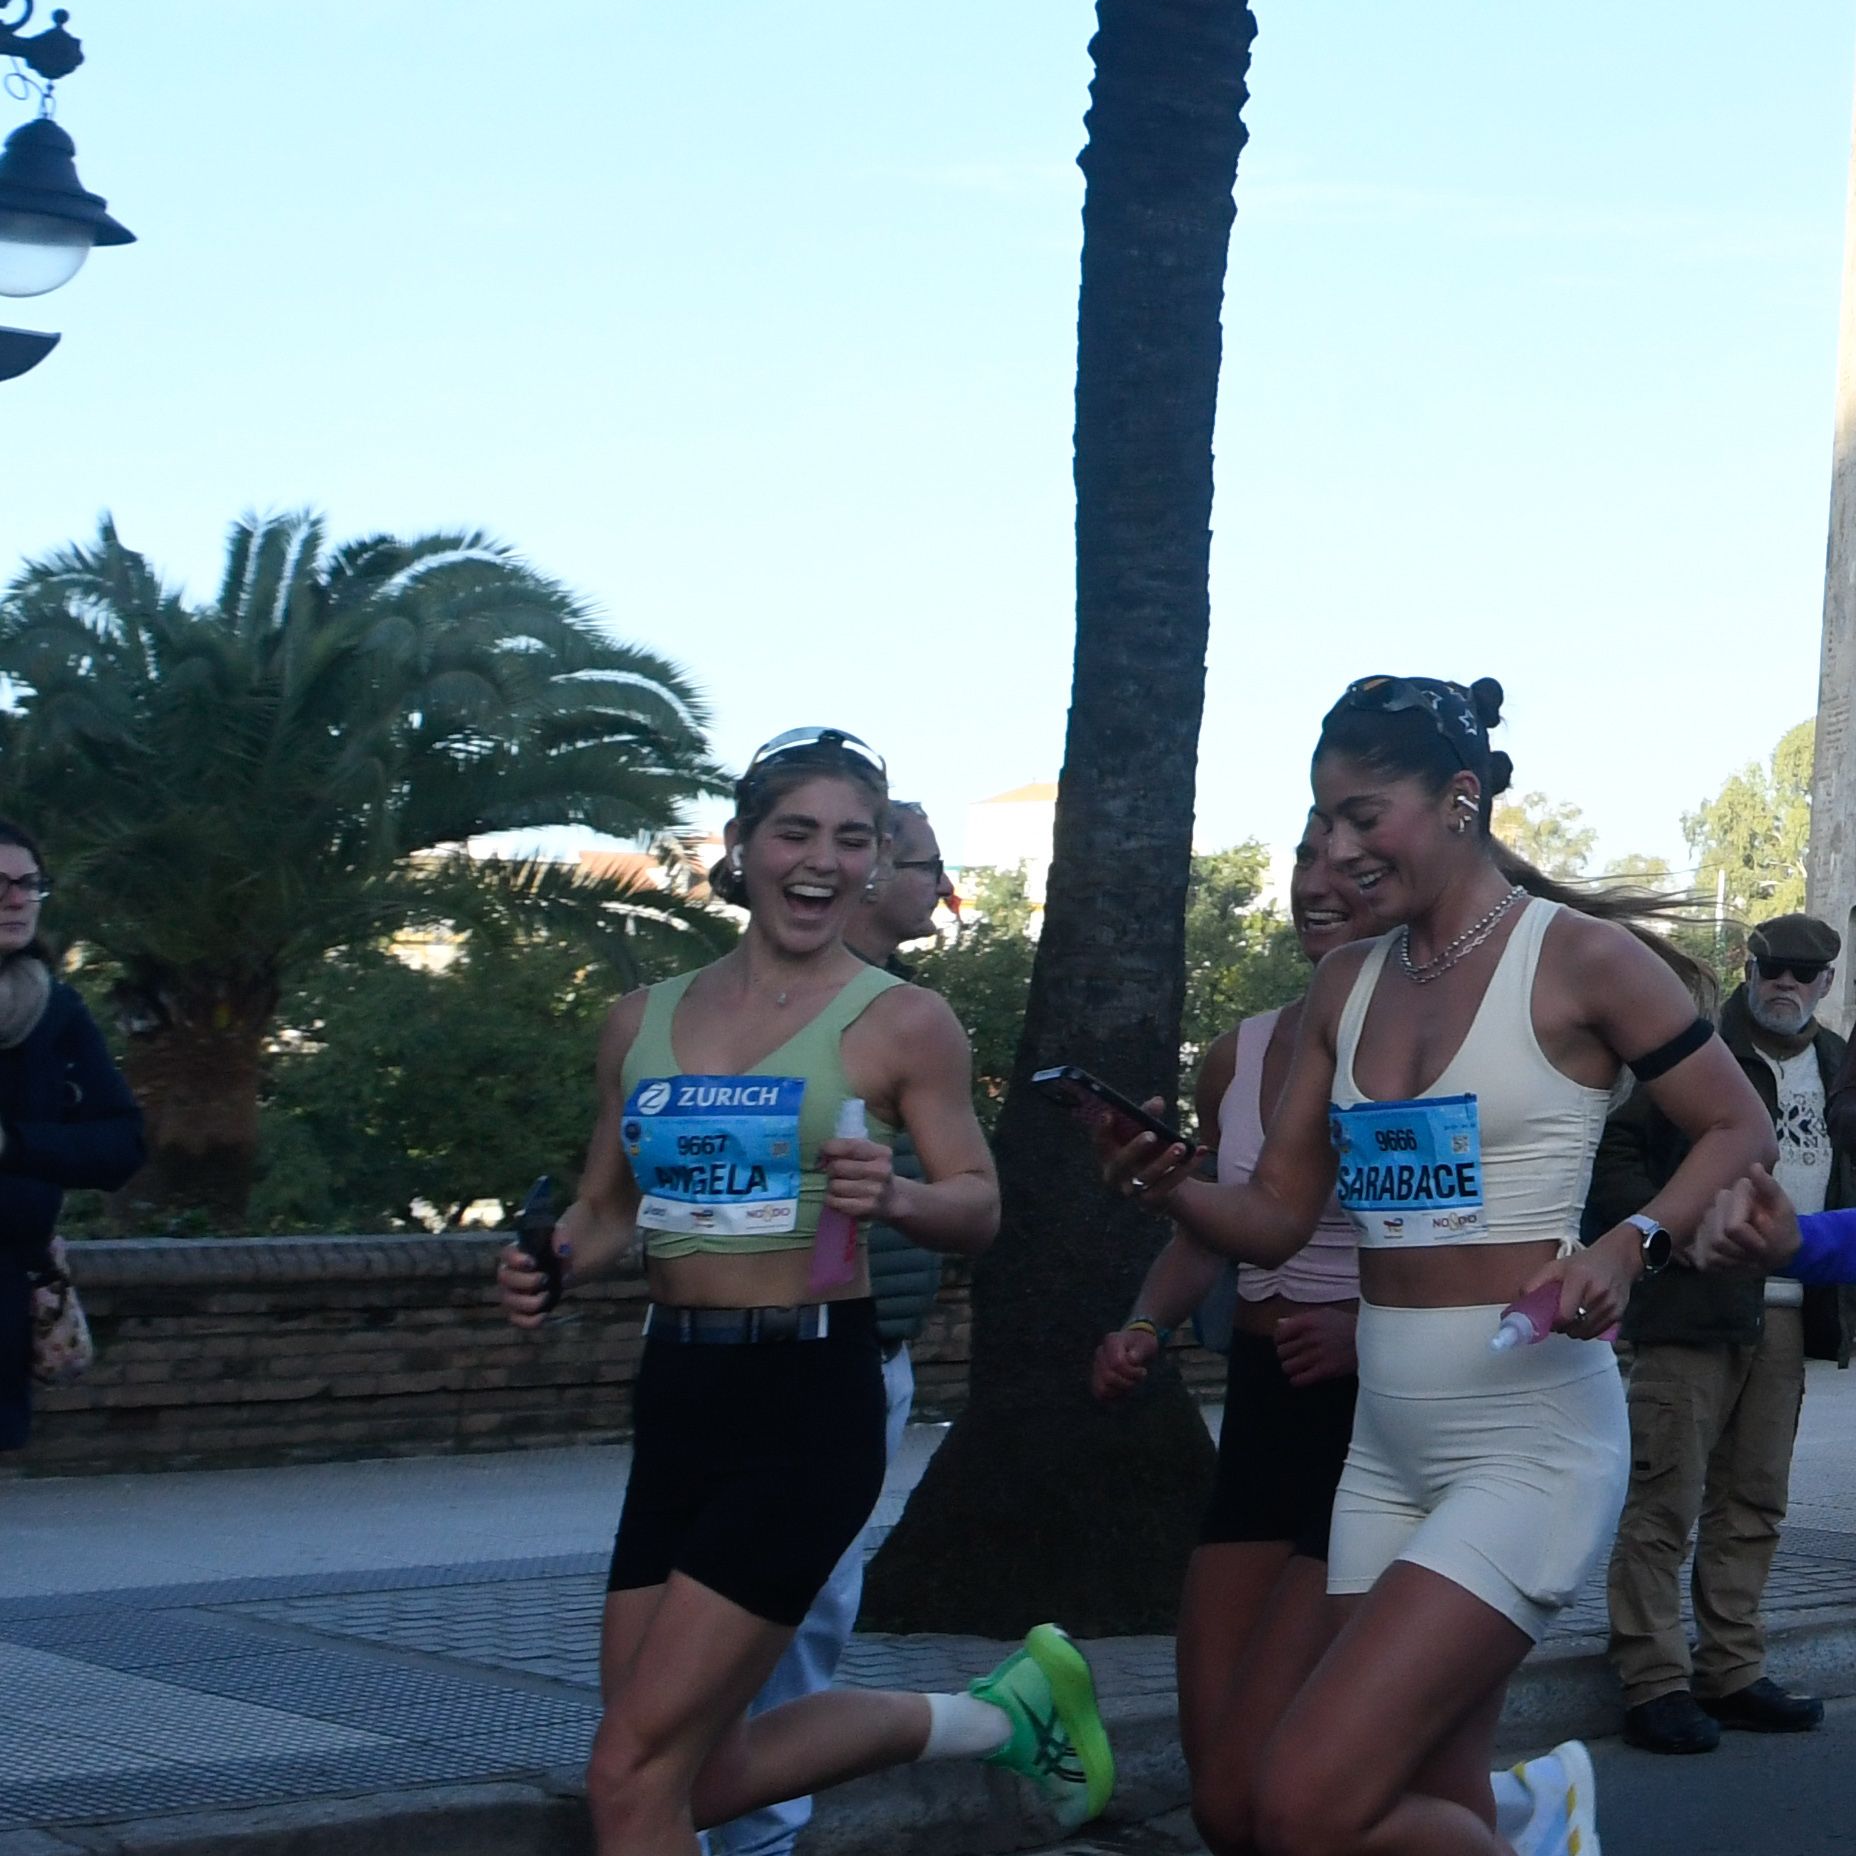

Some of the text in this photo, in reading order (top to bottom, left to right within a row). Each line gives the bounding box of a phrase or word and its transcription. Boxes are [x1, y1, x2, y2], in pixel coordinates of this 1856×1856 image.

[677, 1086, 779, 1107] ZURICH
[677, 1134, 728, 1155] 9667
[1375, 1129, 1418, 1151] 9666
[1338, 1162, 1478, 1201] SARABACE
